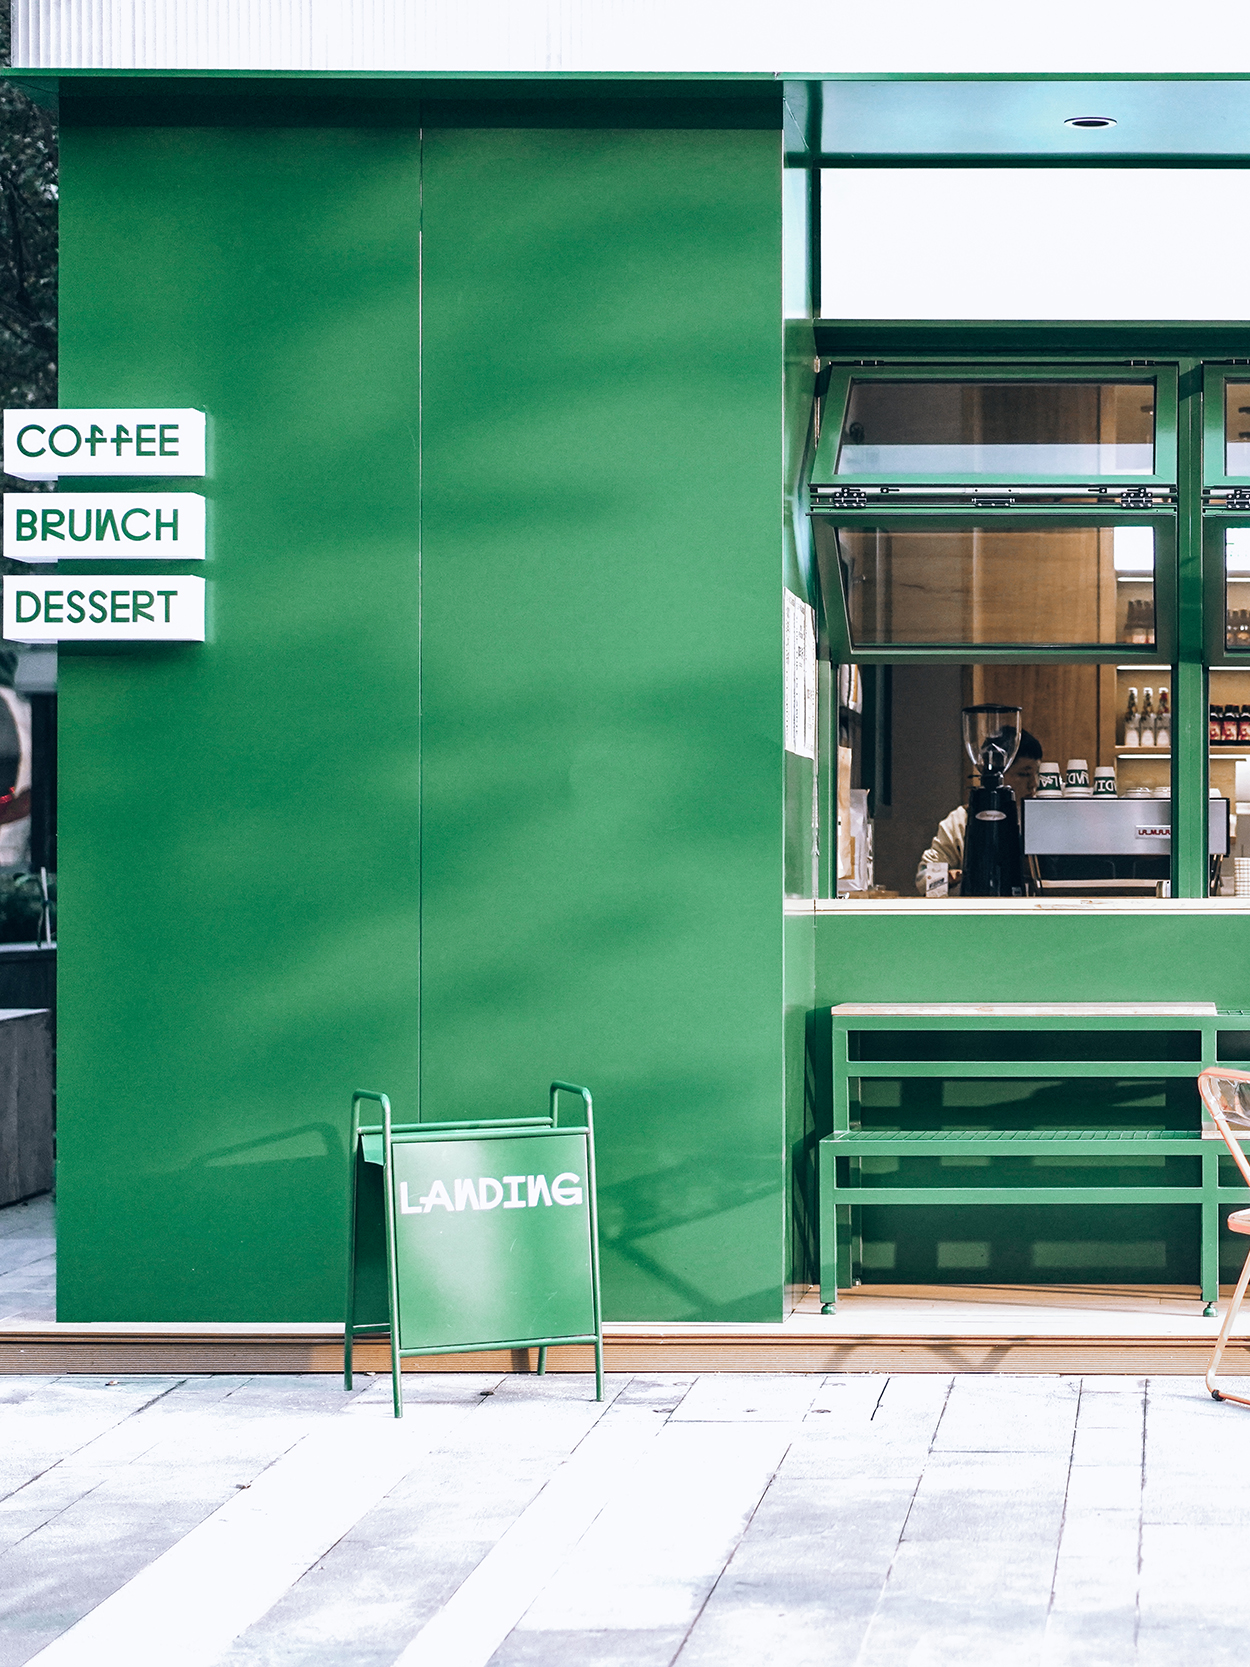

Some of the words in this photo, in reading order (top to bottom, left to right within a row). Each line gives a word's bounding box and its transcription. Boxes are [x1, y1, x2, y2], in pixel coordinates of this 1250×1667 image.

[16, 508, 178, 541] BRUNCH
[16, 590, 178, 623] DESSERT
[400, 1172, 583, 1214] LANDING
